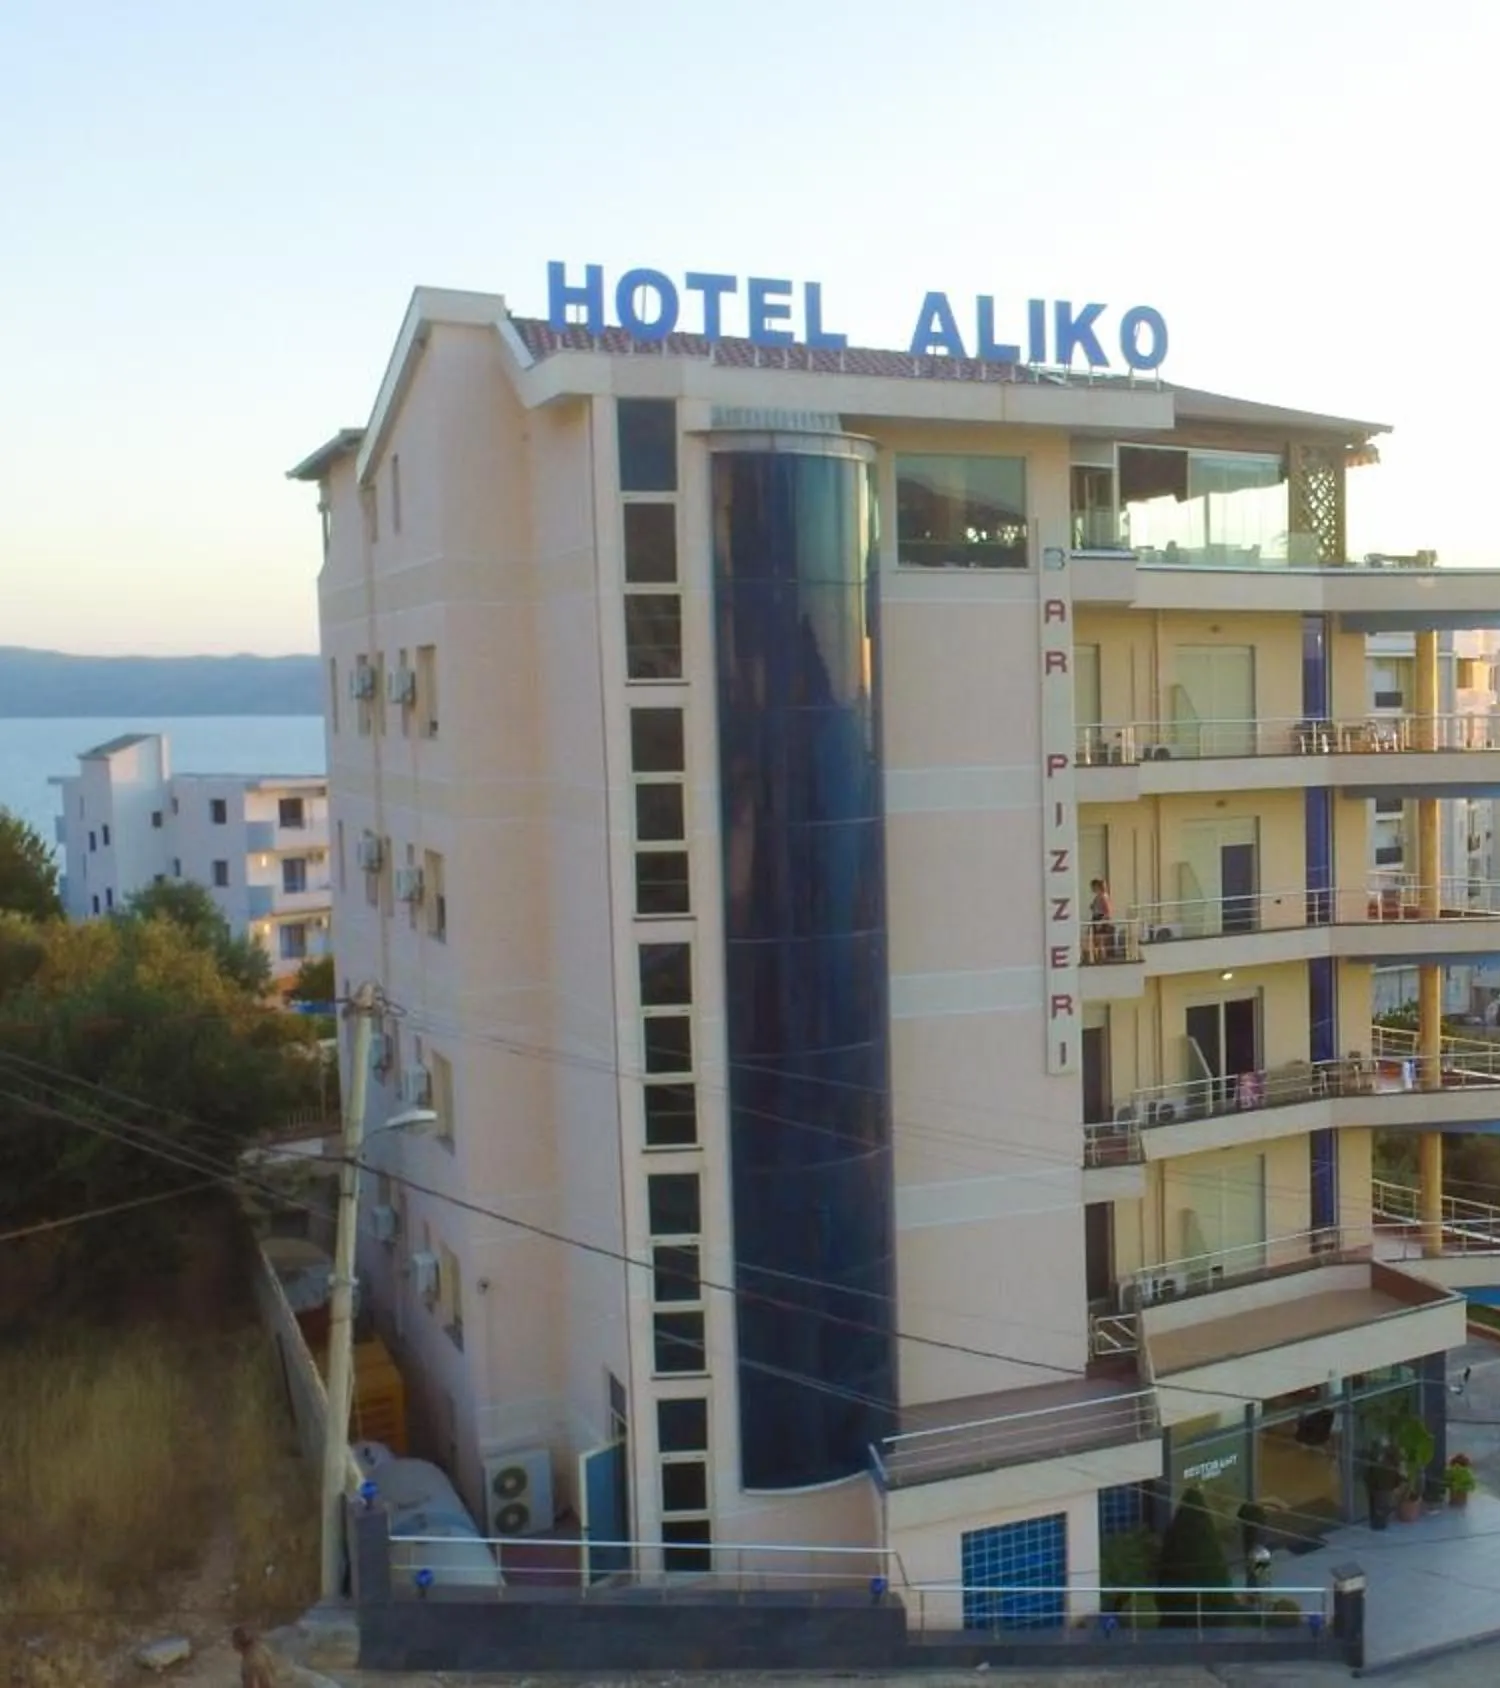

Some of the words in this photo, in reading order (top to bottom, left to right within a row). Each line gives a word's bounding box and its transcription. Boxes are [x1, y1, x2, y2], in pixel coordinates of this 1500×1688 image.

[547, 260, 848, 349] HOTEL
[909, 291, 1169, 371] ALIKO
[1043, 547, 1069, 674] BAR
[1046, 753, 1074, 1065] PIZZERI
